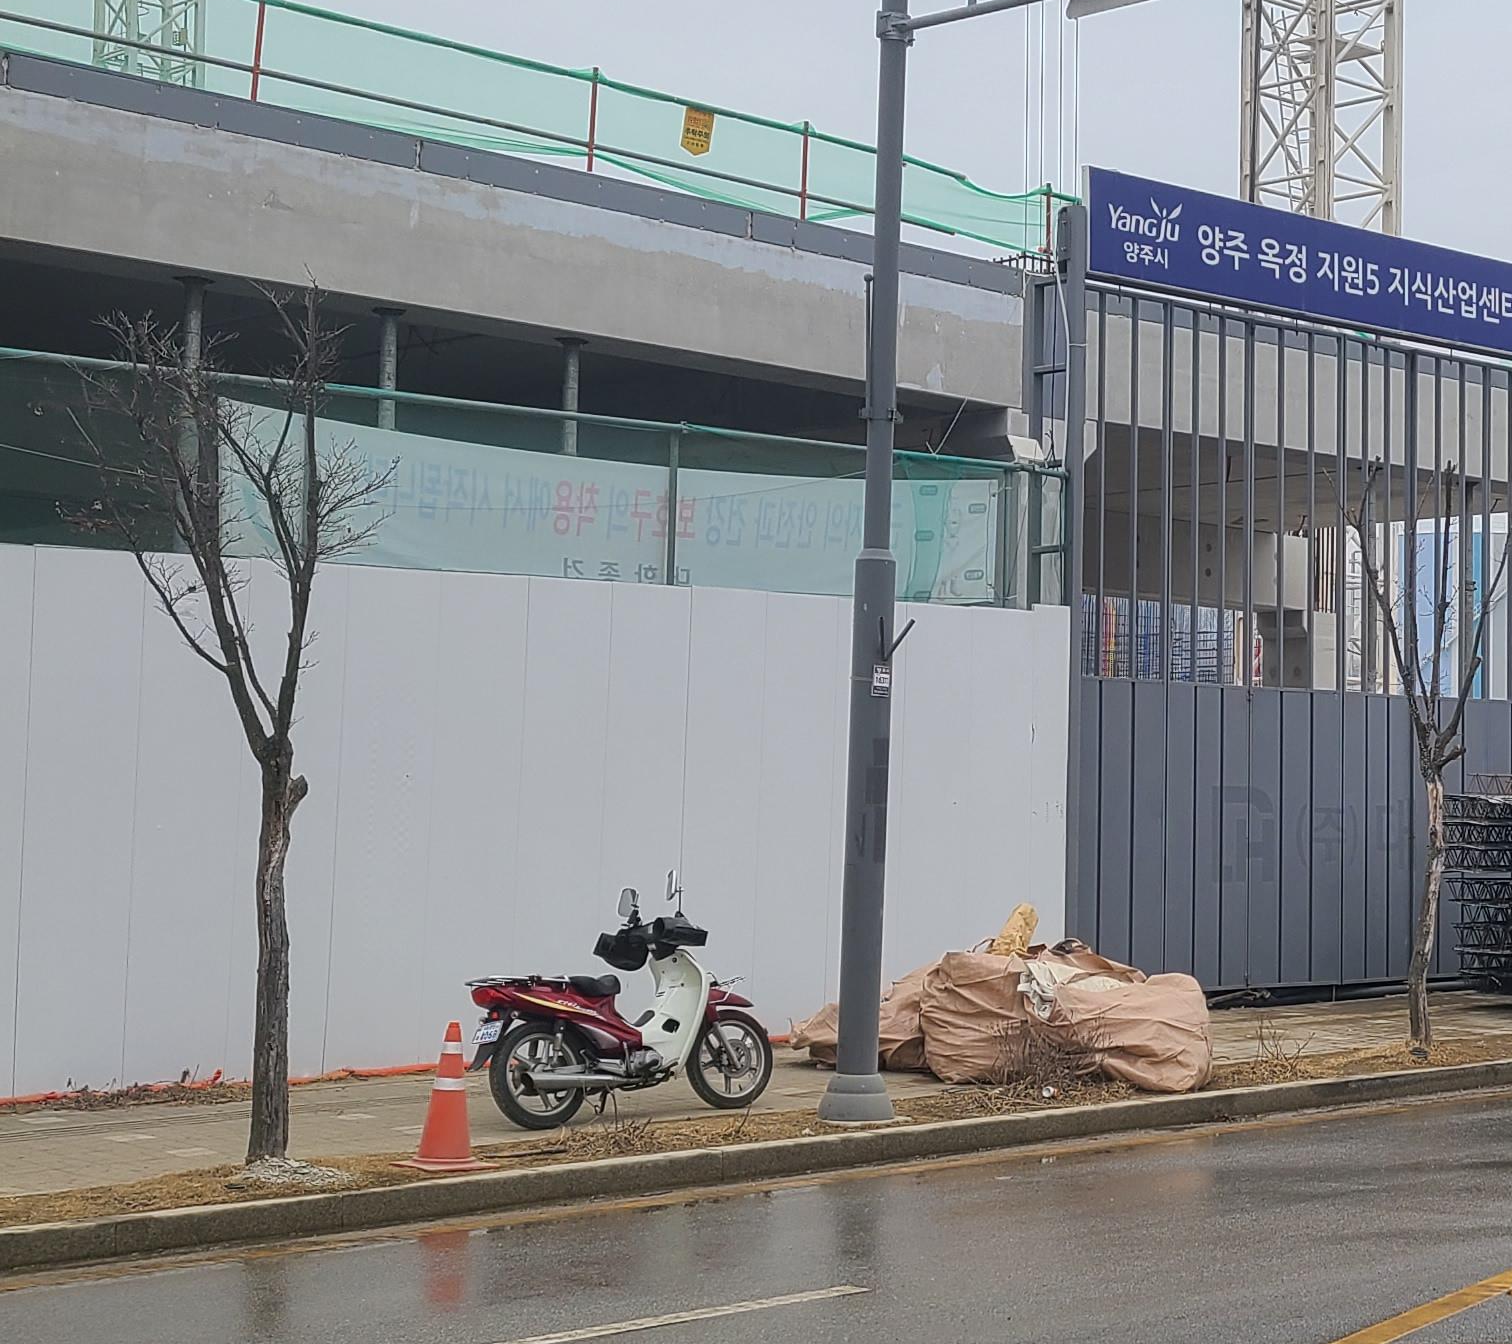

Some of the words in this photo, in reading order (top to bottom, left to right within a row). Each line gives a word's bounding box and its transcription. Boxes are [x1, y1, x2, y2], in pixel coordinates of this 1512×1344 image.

[1123, 241, 1169, 270] 양주시
[1198, 224, 1250, 271] 양주
[1257, 238, 1307, 284] 옥정
[1316, 251, 1380, 297] 지원5
